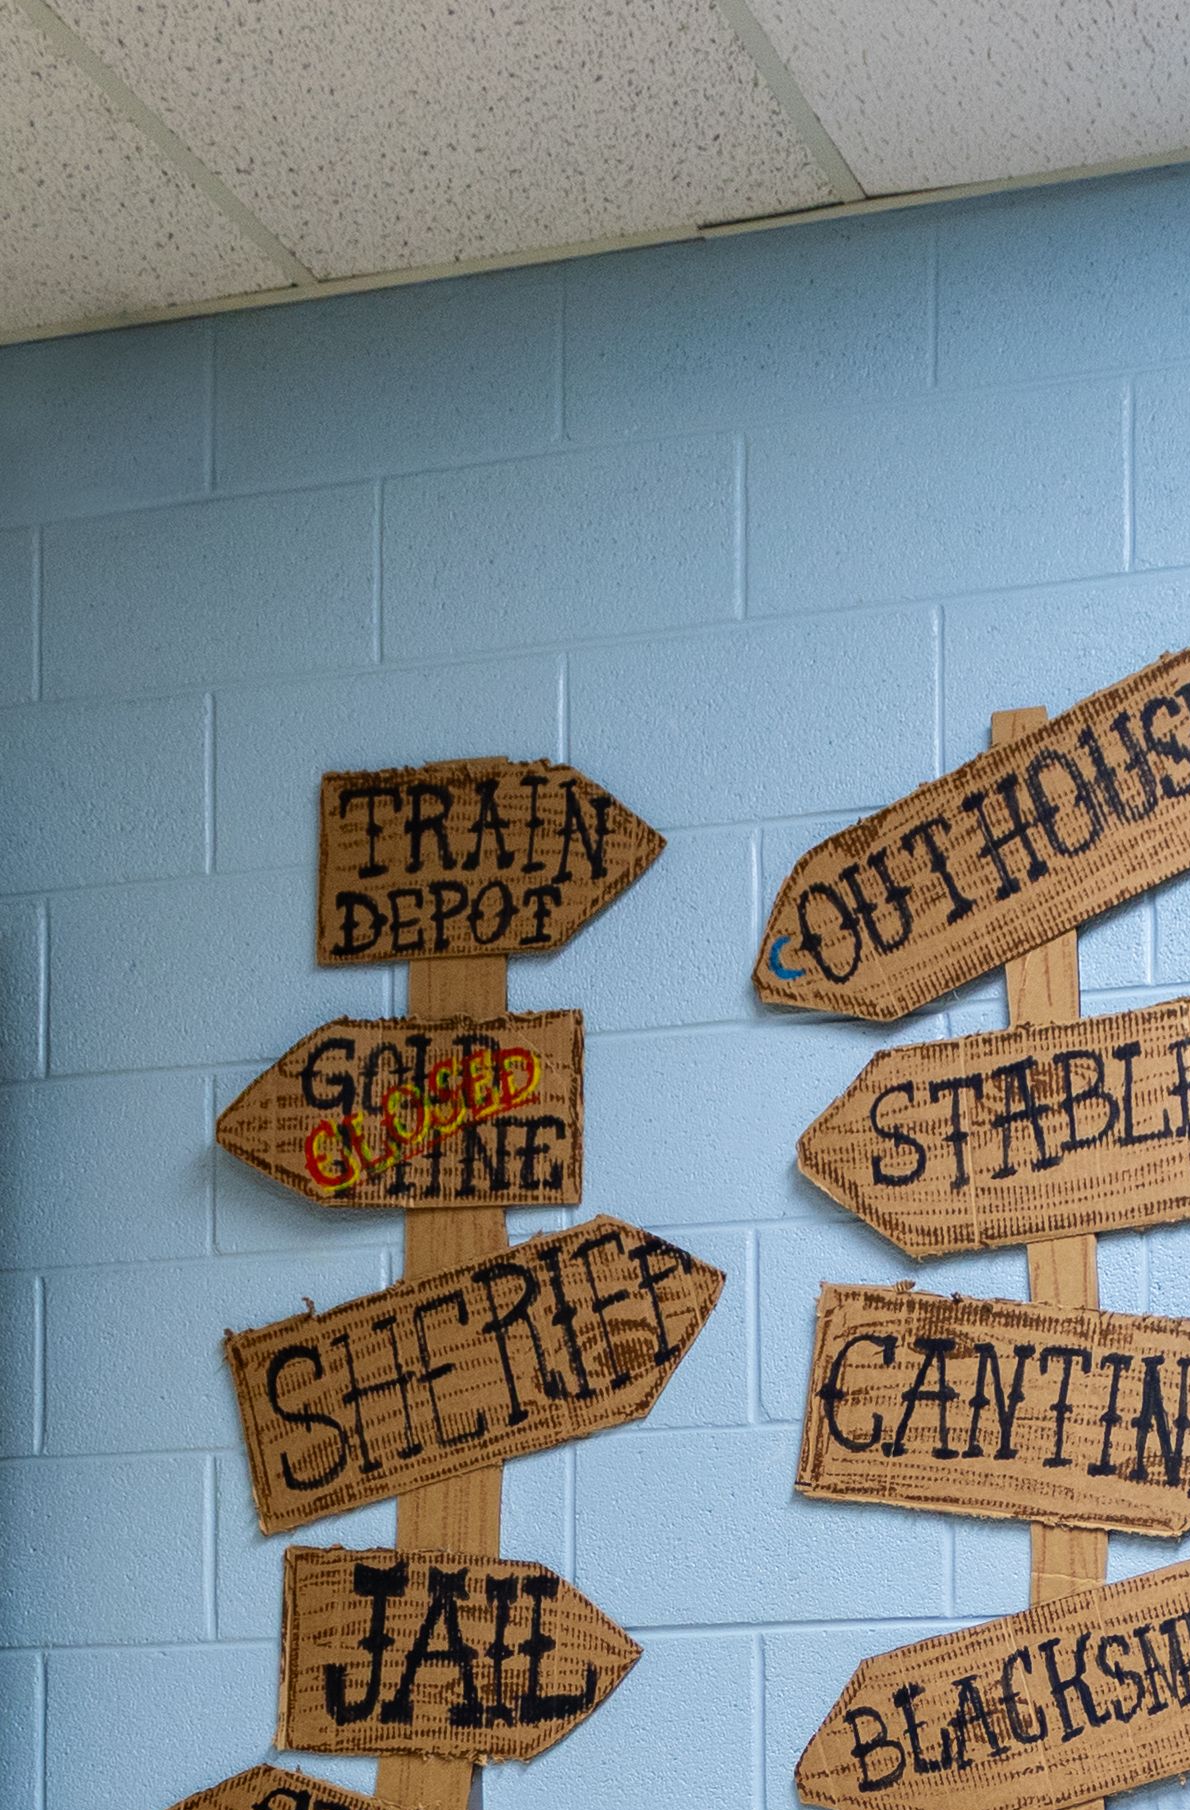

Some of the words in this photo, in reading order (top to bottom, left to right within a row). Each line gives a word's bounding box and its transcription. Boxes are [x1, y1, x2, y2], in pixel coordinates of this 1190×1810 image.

[338, 775, 615, 884] TRAIN
[331, 880, 562, 957] DEPOT
[304, 1046, 540, 1192] CLOSED
[266, 1233, 693, 1491] SHERIFF
[325, 1562, 597, 1728] JAIL
